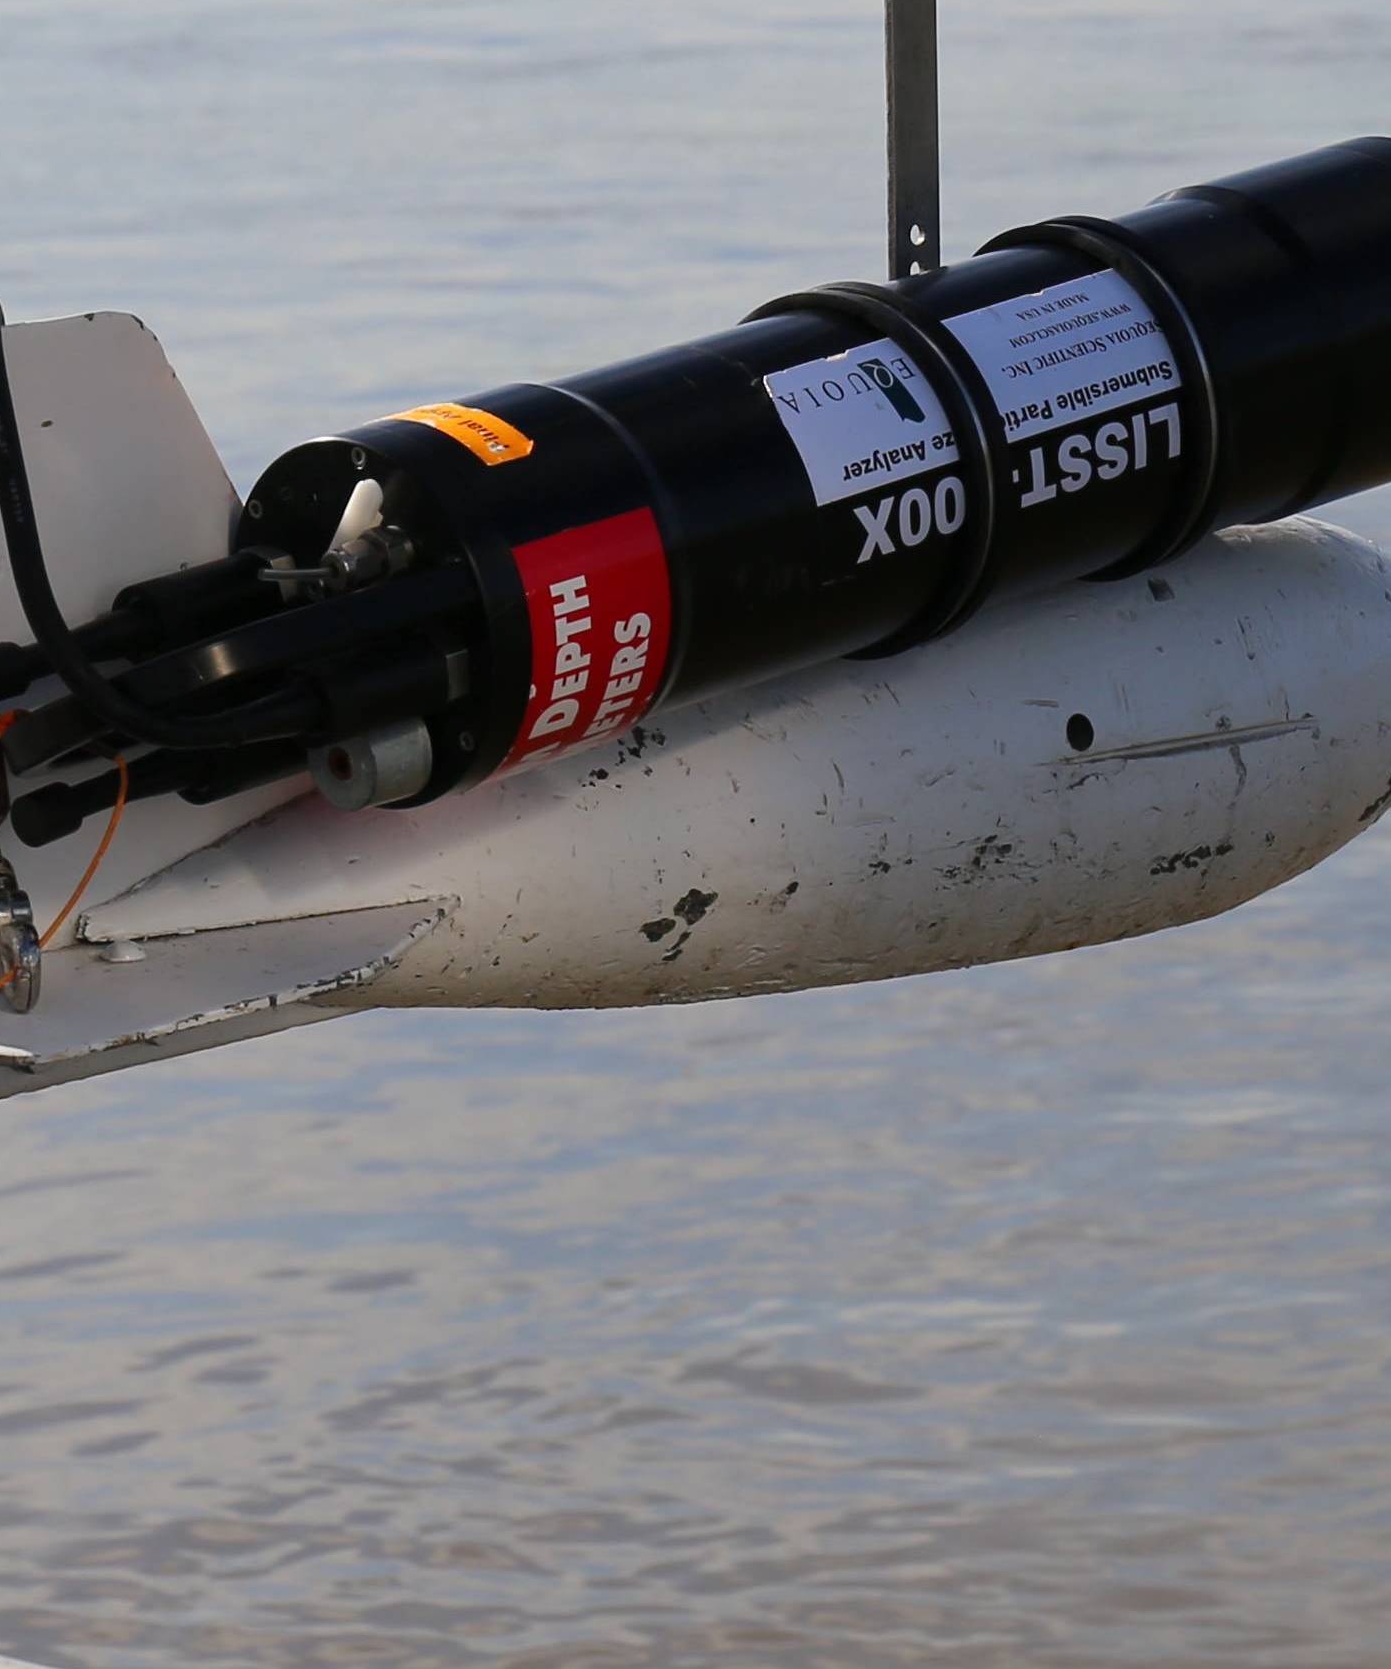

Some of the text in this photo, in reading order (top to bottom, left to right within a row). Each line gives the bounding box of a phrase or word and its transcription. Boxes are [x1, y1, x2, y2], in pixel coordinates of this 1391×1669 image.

[1015, 292, 1090, 322] MADE IN USA
[1000, 361, 1034, 378] INC.
[1036, 333, 1107, 369] SCIENTIFIC
[1056, 360, 1173, 409] Submersible
[459, 419, 509, 452] inal
[843, 440, 926, 482] Analyzer
[528, 574, 592, 740] DEPTH
[577, 612, 652, 741] ETERS
